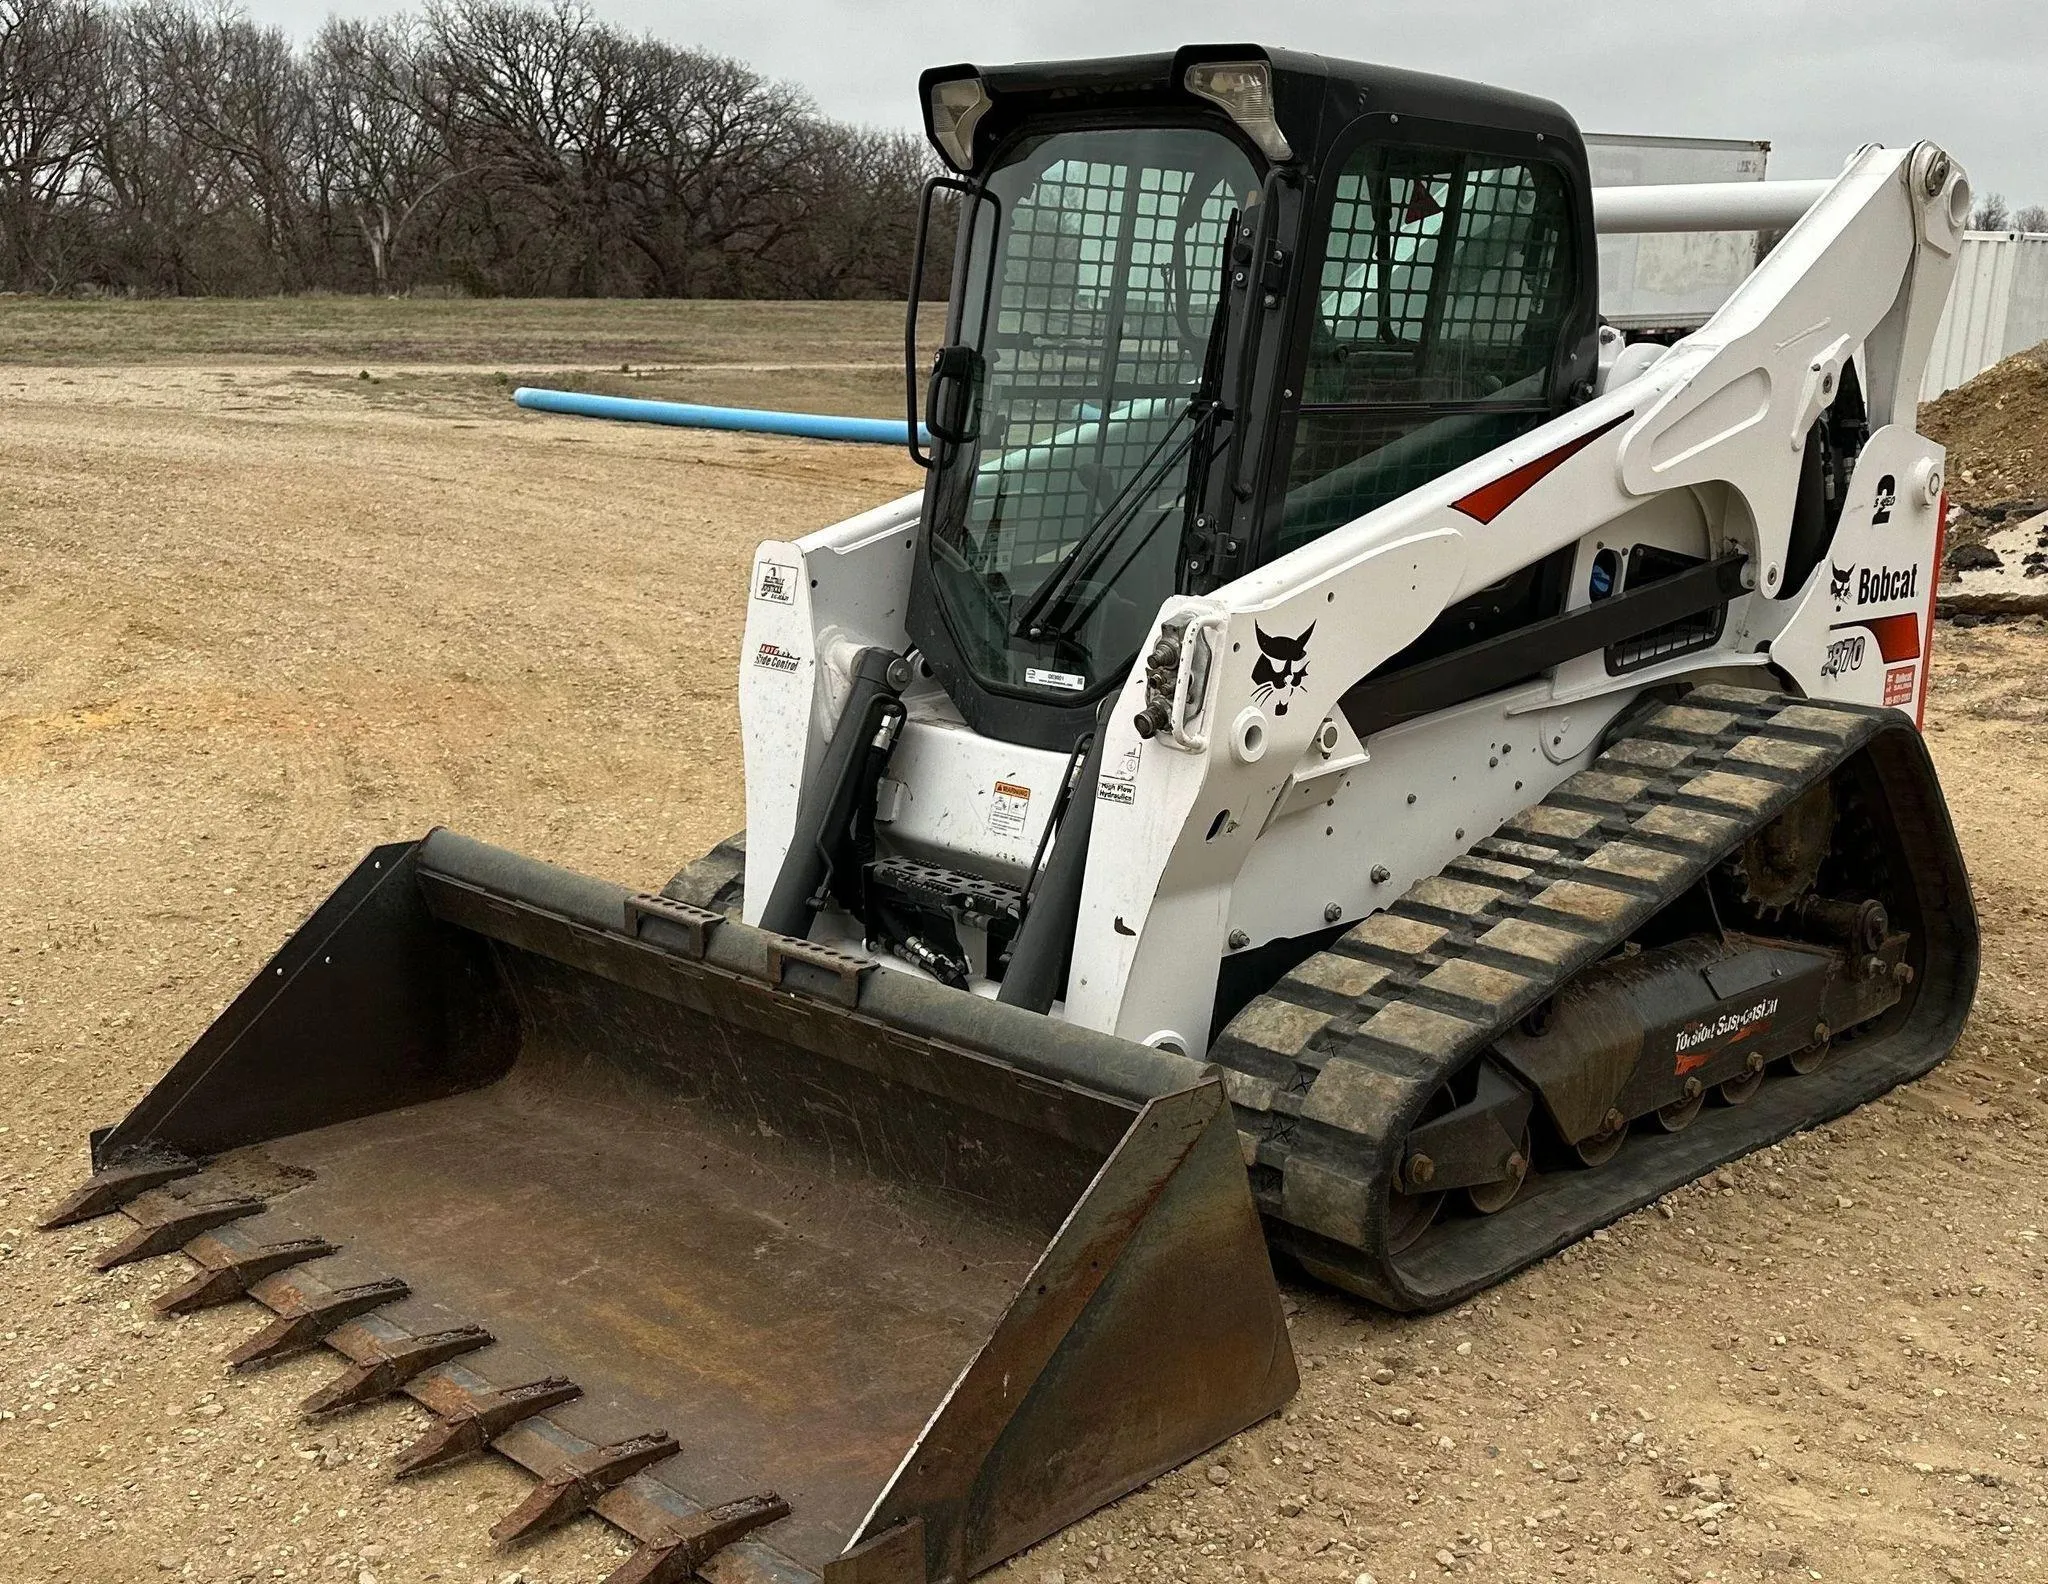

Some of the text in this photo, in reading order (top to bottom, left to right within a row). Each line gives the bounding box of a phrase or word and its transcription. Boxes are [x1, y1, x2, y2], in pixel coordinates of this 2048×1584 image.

[1872, 474, 1895, 525] 2
[1857, 563, 1918, 605] Bobcat
[770, 656, 799, 672] Control
[1099, 789, 1133, 801] Hydraulics
[1117, 784, 1133, 793] Flow
